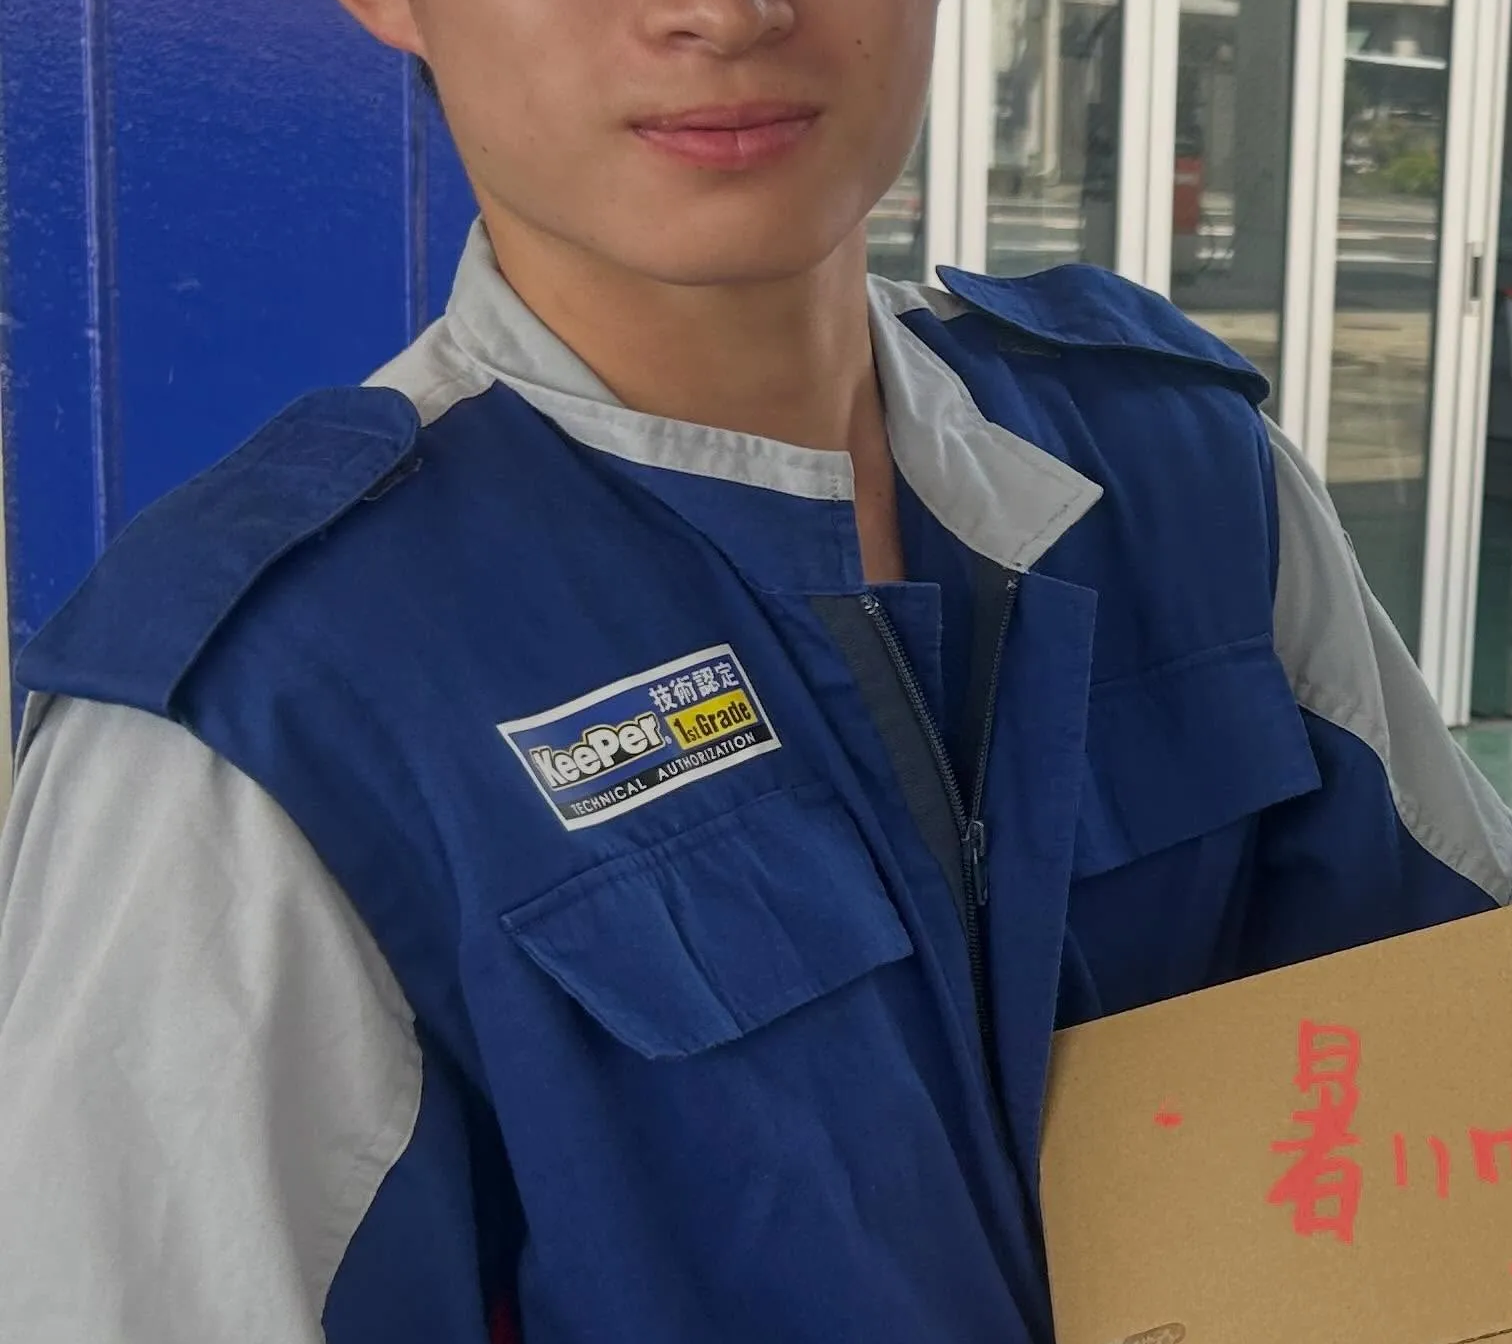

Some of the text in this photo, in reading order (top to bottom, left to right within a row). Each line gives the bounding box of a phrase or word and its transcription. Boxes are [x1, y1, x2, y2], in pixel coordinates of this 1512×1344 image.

[648, 662, 739, 713] 技術認定
[529, 711, 666, 791] KeePer
[571, 731, 756, 816] TECHNICAL AUTHORIZATION
